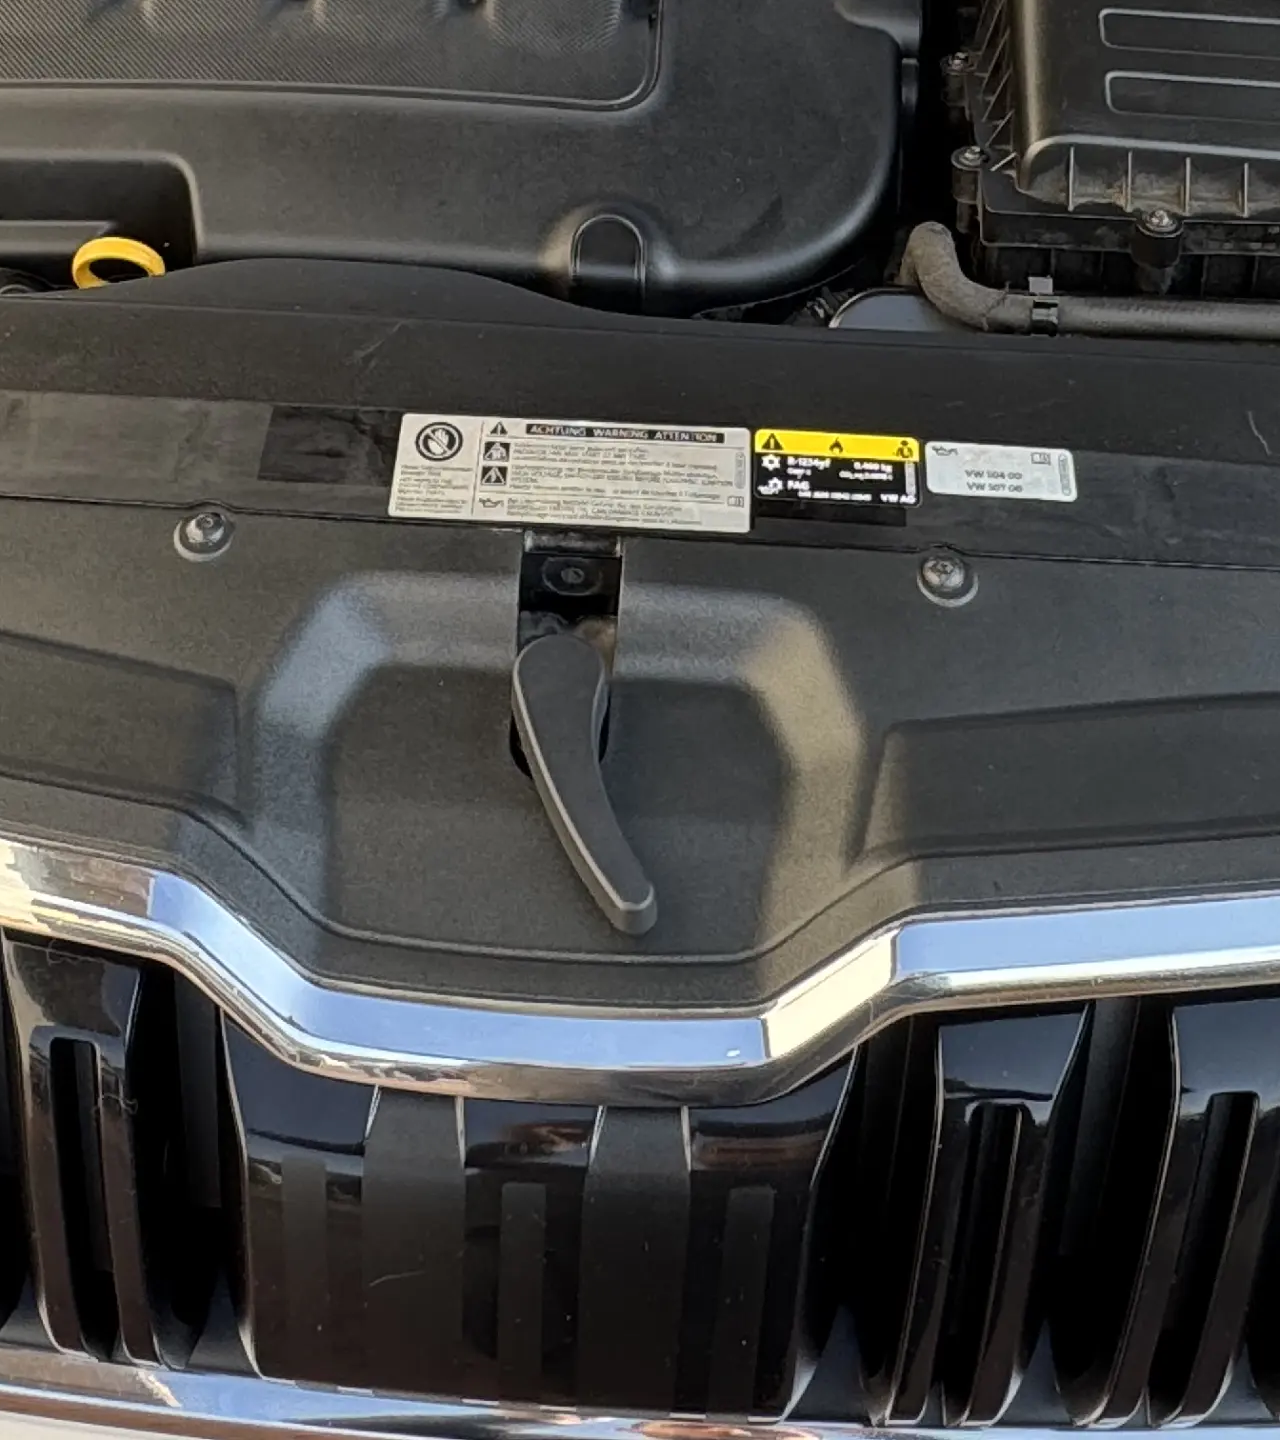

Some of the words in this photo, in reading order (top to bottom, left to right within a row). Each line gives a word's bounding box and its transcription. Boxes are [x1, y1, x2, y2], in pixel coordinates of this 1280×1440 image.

[530, 424, 586, 436] ACHTUNG
[593, 427, 648, 439] WARNING
[654, 430, 717, 443] ATTENTION
[965, 469, 984, 478] VW
[967, 482, 985, 491] VW
